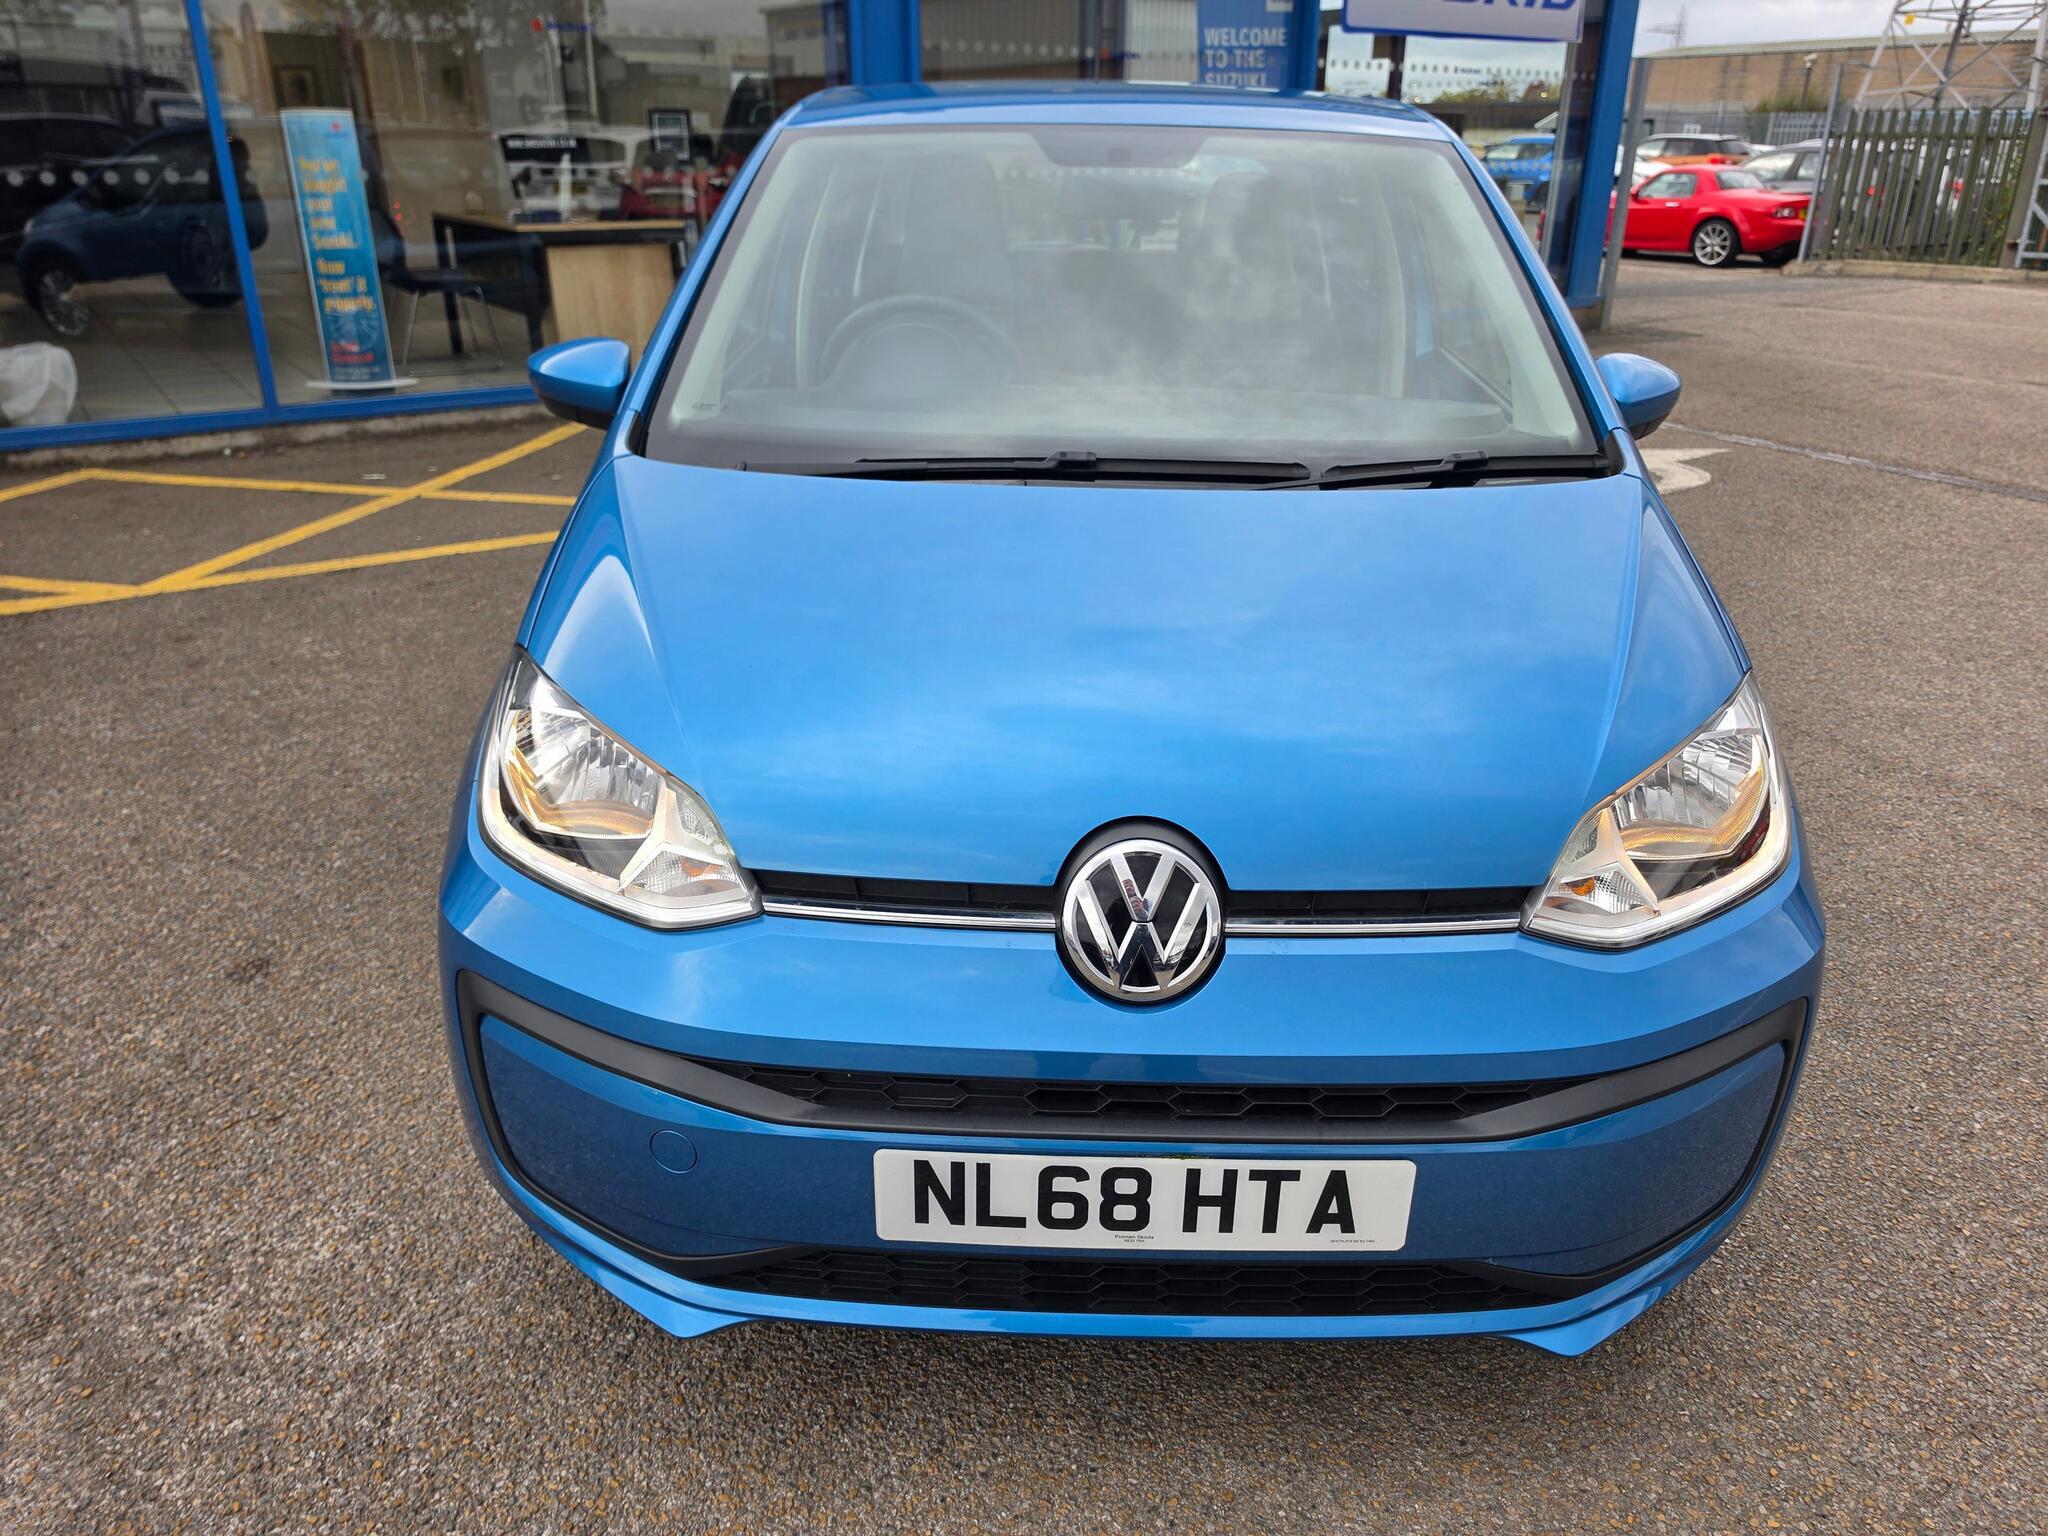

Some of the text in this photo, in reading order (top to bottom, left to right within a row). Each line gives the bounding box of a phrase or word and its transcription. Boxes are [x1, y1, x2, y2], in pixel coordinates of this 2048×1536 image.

[1204, 27, 1287, 47] WELCOME
[1204, 49, 1266, 69] TO THE
[1204, 72, 1267, 86] SUZUKI
[914, 1160, 1356, 1234] NL68 HTA
